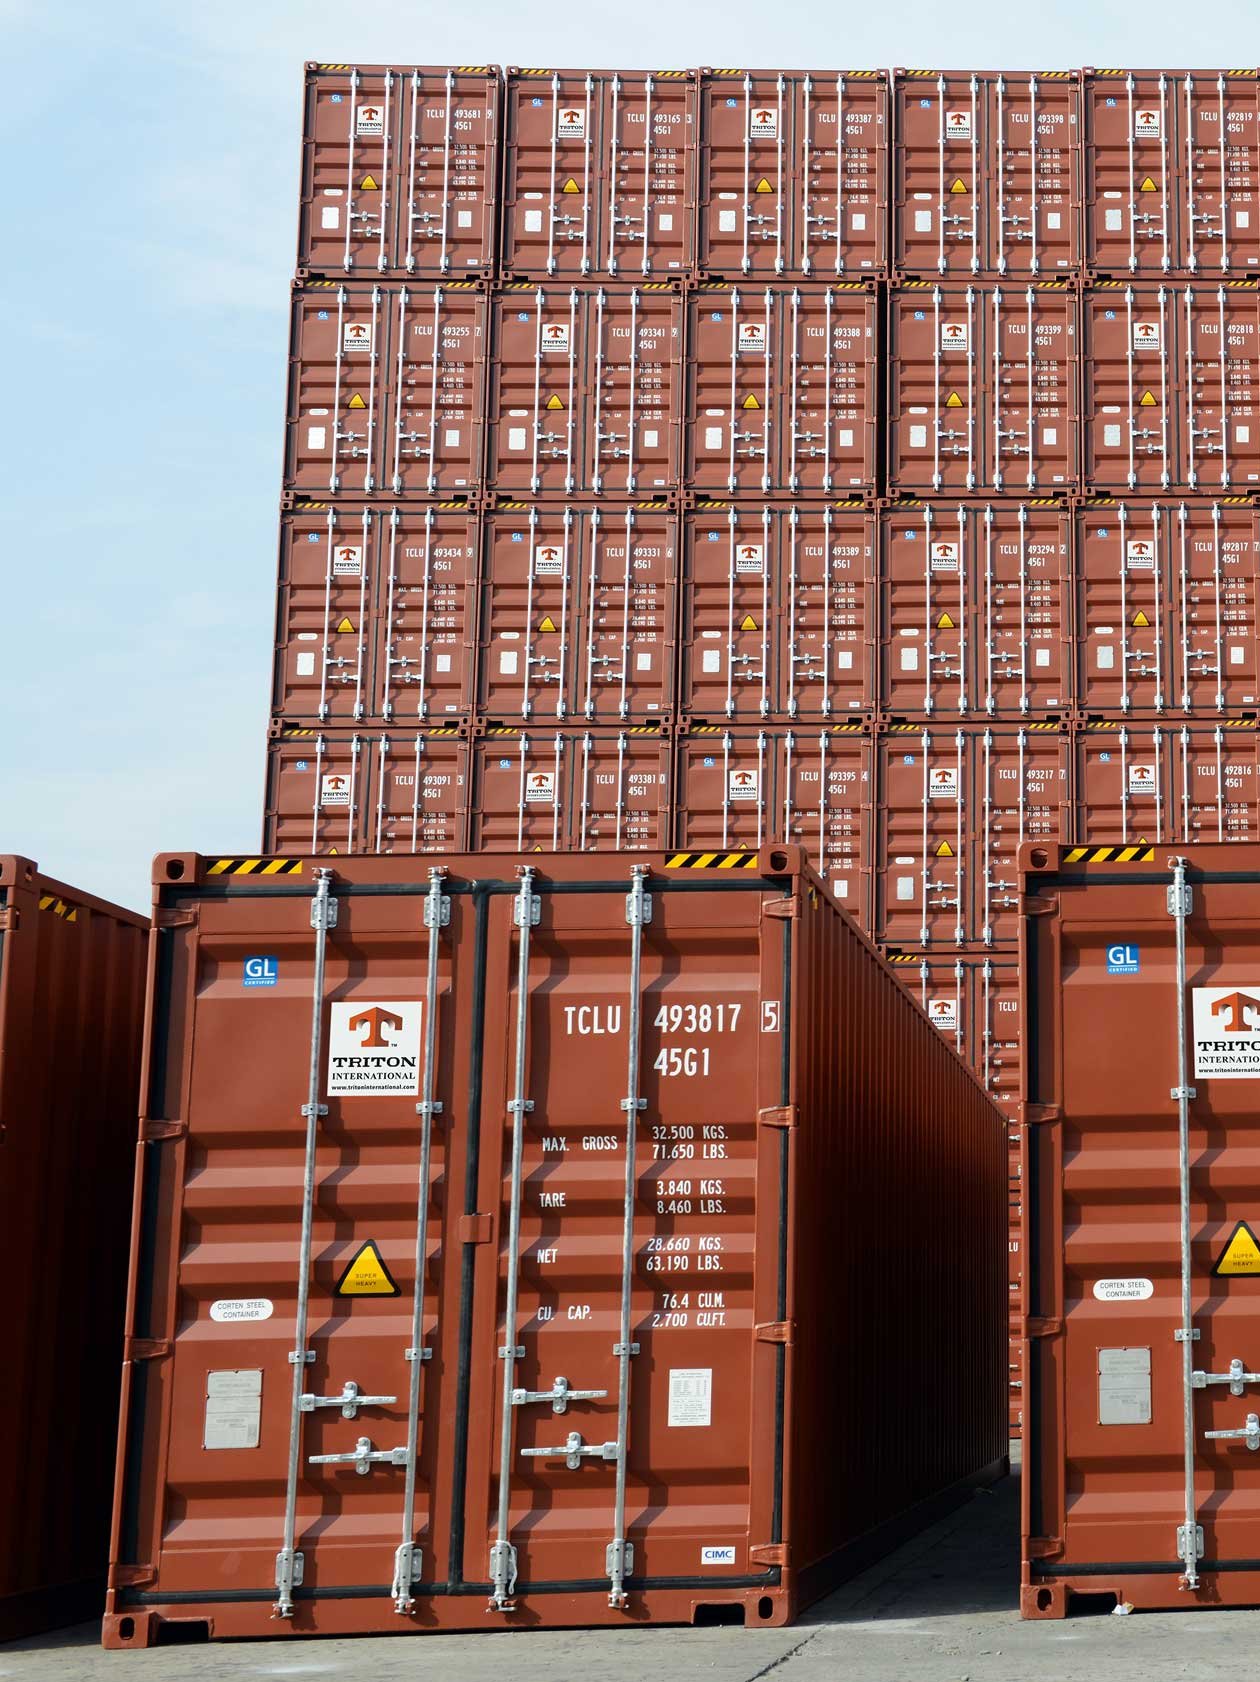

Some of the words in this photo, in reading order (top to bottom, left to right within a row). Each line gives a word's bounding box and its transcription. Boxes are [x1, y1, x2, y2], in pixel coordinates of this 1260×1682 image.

[426, 109, 444, 118] TCLU
[454, 110, 481, 119] 493681
[1011, 114, 1029, 123] TCLU
[1037, 114, 1064, 123] 493398
[454, 121, 472, 131] 45G1
[1037, 125, 1054, 134] 45G1
[414, 326, 432, 335] TCLU
[442, 327, 470, 336] 493255
[442, 339, 460, 348] 45G1
[1194, 542, 1212, 551] TCLU
[1221, 542, 1248, 551] 492817
[405, 548, 424, 557] TCLU
[433, 548, 461, 557] 493434
[1222, 554, 1240, 563] 45G1
[433, 561, 452, 570] 45G1
[800, 772, 818, 781] TCLU
[828, 772, 856, 781] 493395
[828, 785, 846, 794] 45G1
[1108, 946, 1137, 965] GL
[246, 959, 275, 977] GL
[564, 1005, 621, 1035] TCLU
[653, 1004, 741, 1034] 493817
[764, 1003, 777, 1031] 5
[332, 1057, 416, 1068] TRITON
[653, 1048, 710, 1077] 45G1
[332, 1072, 415, 1080] INTERNATIONAL
[703, 1125, 729, 1139] KGS.
[542, 1136, 570, 1152] MAX.
[582, 1136, 618, 1151] GROSS
[702, 1144, 729, 1159] LBS.
[700, 1179, 726, 1195] KGS.
[539, 1192, 566, 1208] TARE
[700, 1199, 727, 1213] LBS.
[698, 1236, 724, 1250] KGS.
[537, 1248, 558, 1264] NET
[697, 1255, 724, 1270] LBS.
[1106, 1290, 1140, 1298] CONTAINER
[217, 1302, 243, 1310] CORTEN
[247, 1301, 265, 1309] STEEL
[662, 1293, 689, 1309] 76.4
[698, 1293, 725, 1308] CU.M.
[537, 1307, 554, 1321] CU.
[567, 1305, 592, 1320] CAP.
[696, 1312, 726, 1326] CU.FT.
[704, 1550, 733, 1559] CIMC
